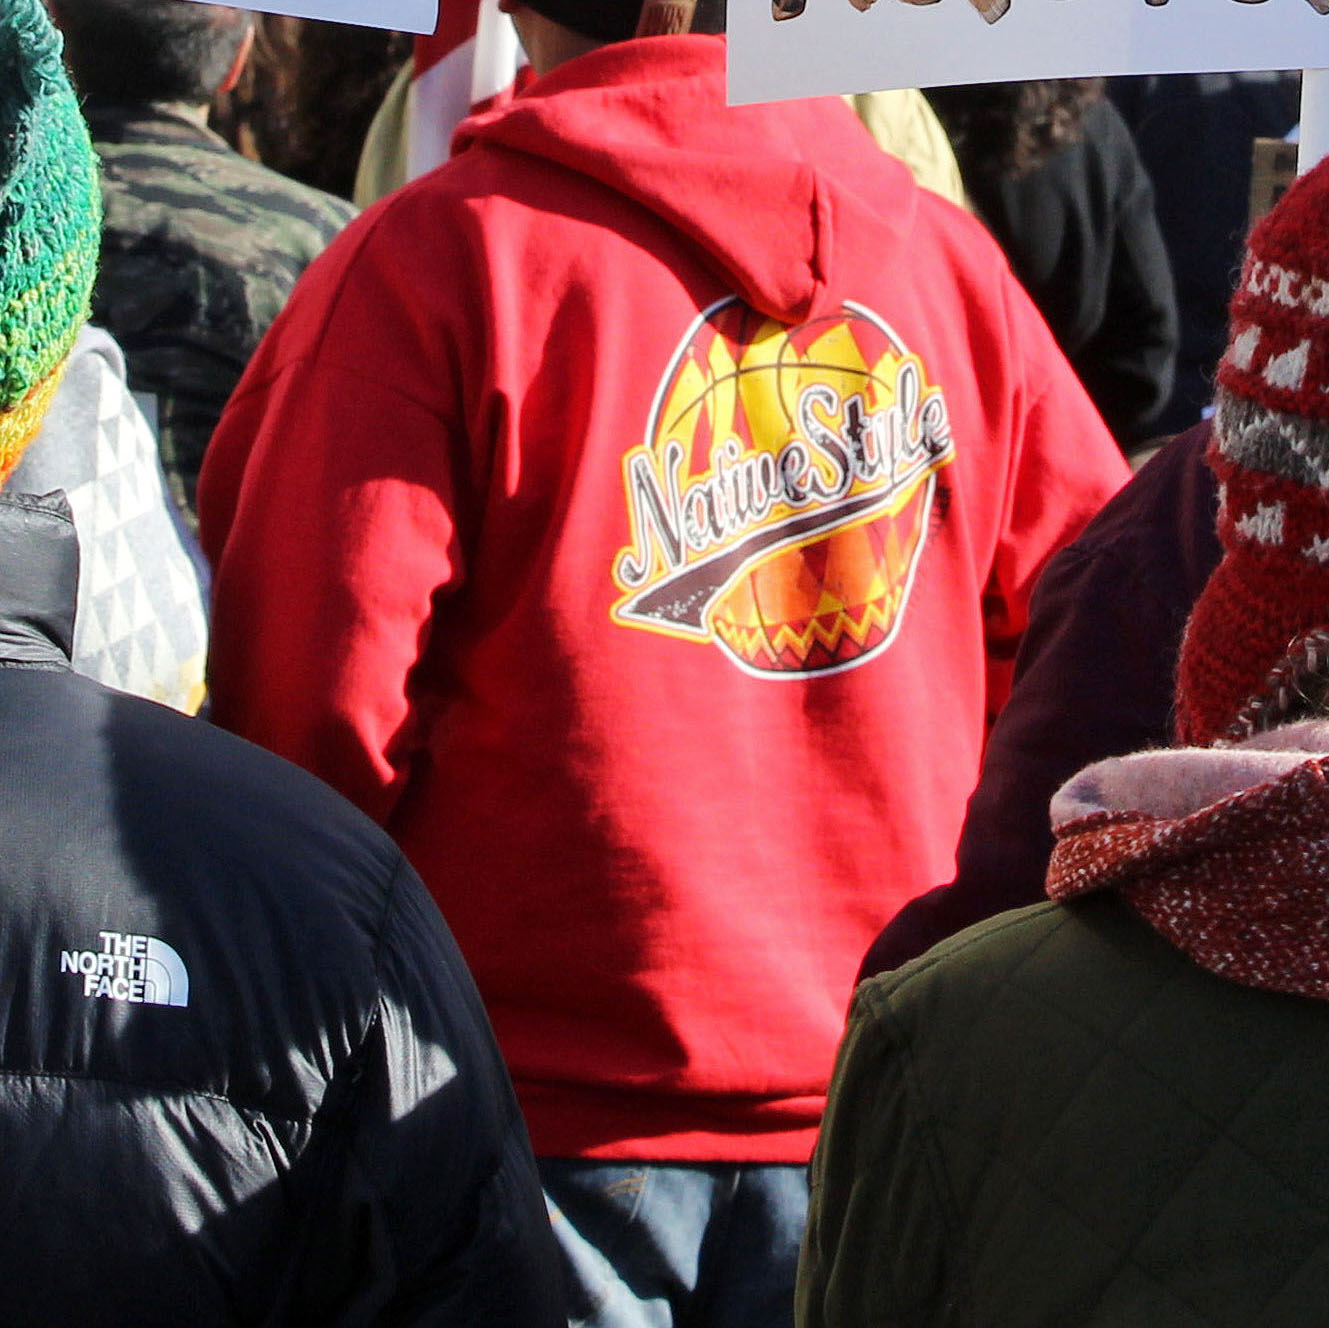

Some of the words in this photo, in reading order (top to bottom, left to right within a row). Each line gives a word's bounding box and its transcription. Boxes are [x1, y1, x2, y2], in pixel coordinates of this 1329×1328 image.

[99, 931, 148, 958] THE
[60, 950, 145, 980] NORTH
[83, 975, 144, 1002] FACE
